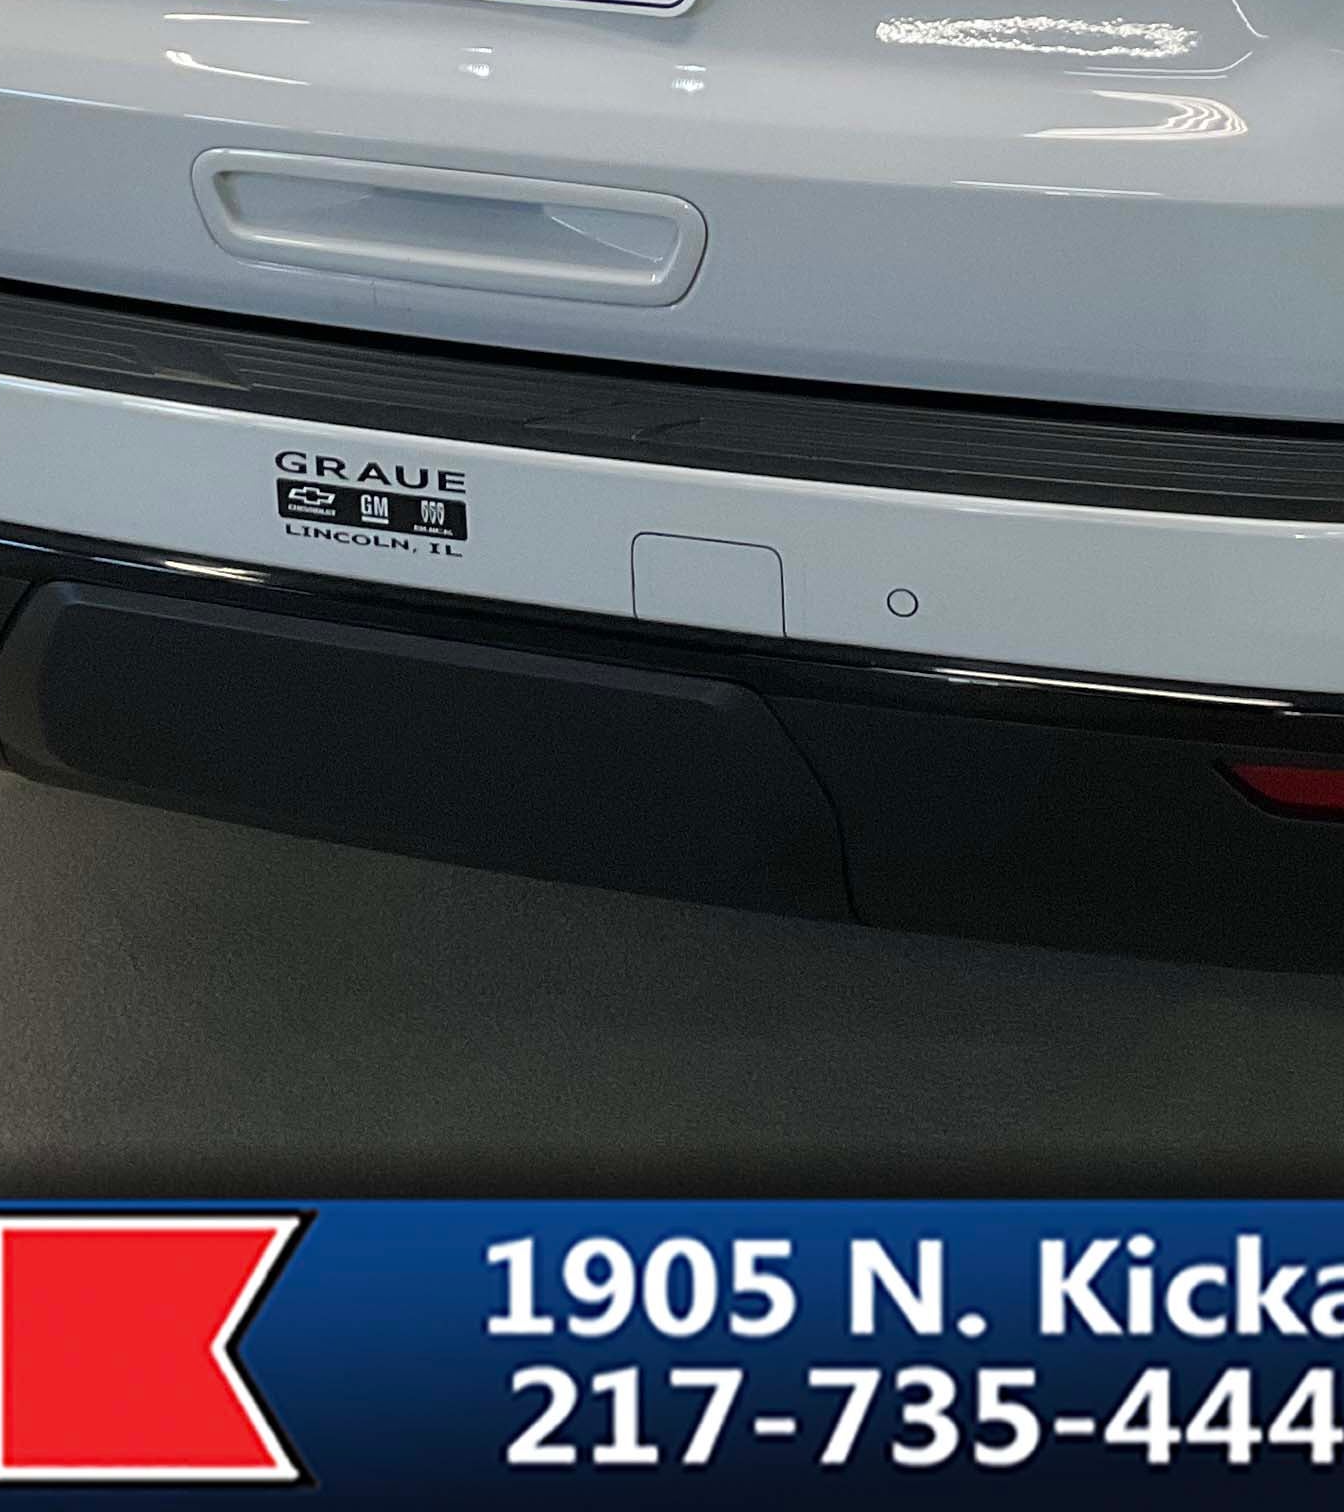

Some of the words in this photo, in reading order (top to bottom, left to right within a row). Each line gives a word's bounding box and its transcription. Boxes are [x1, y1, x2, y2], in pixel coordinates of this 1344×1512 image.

[274, 450, 467, 494] GRAUE
[360, 493, 390, 520] GM
[285, 523, 418, 554] LINCOLN,
[429, 541, 464, 558] IL
